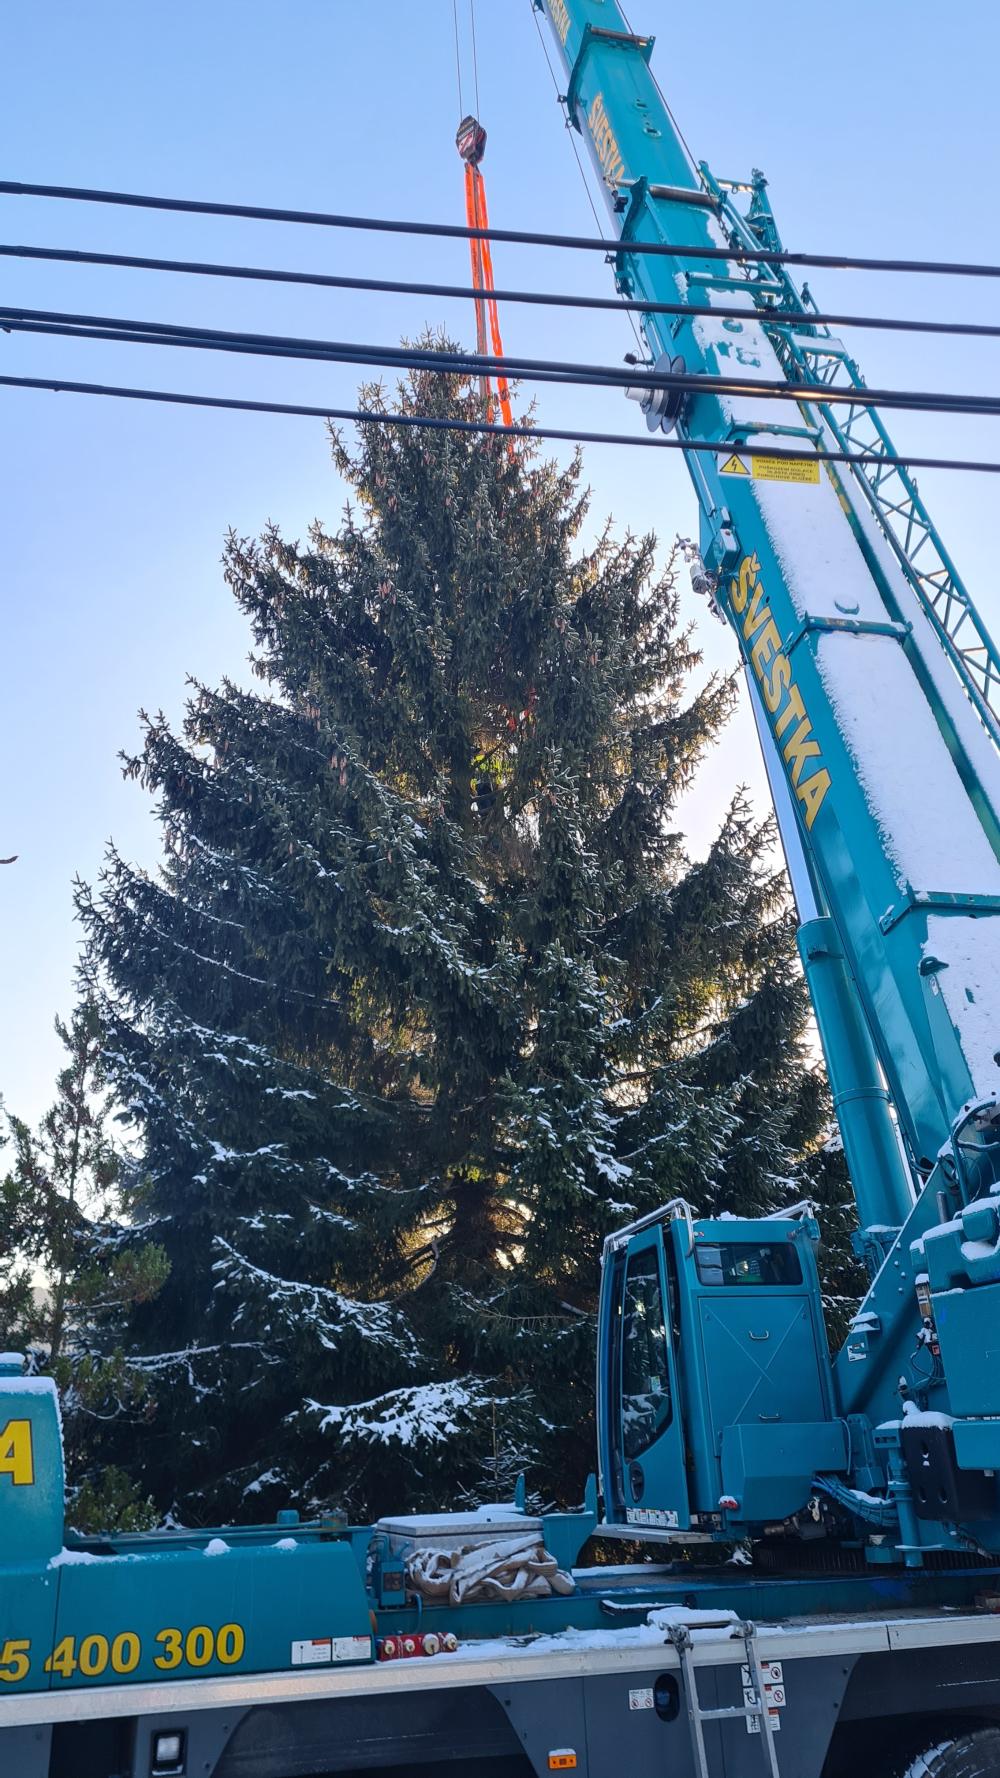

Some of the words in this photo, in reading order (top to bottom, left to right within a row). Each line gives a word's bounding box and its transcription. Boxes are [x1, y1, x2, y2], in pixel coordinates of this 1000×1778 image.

[731, 552, 832, 832] ŠVESTKA
[44, 1632, 141, 1679] 400
[153, 1623, 245, 1670] 300
